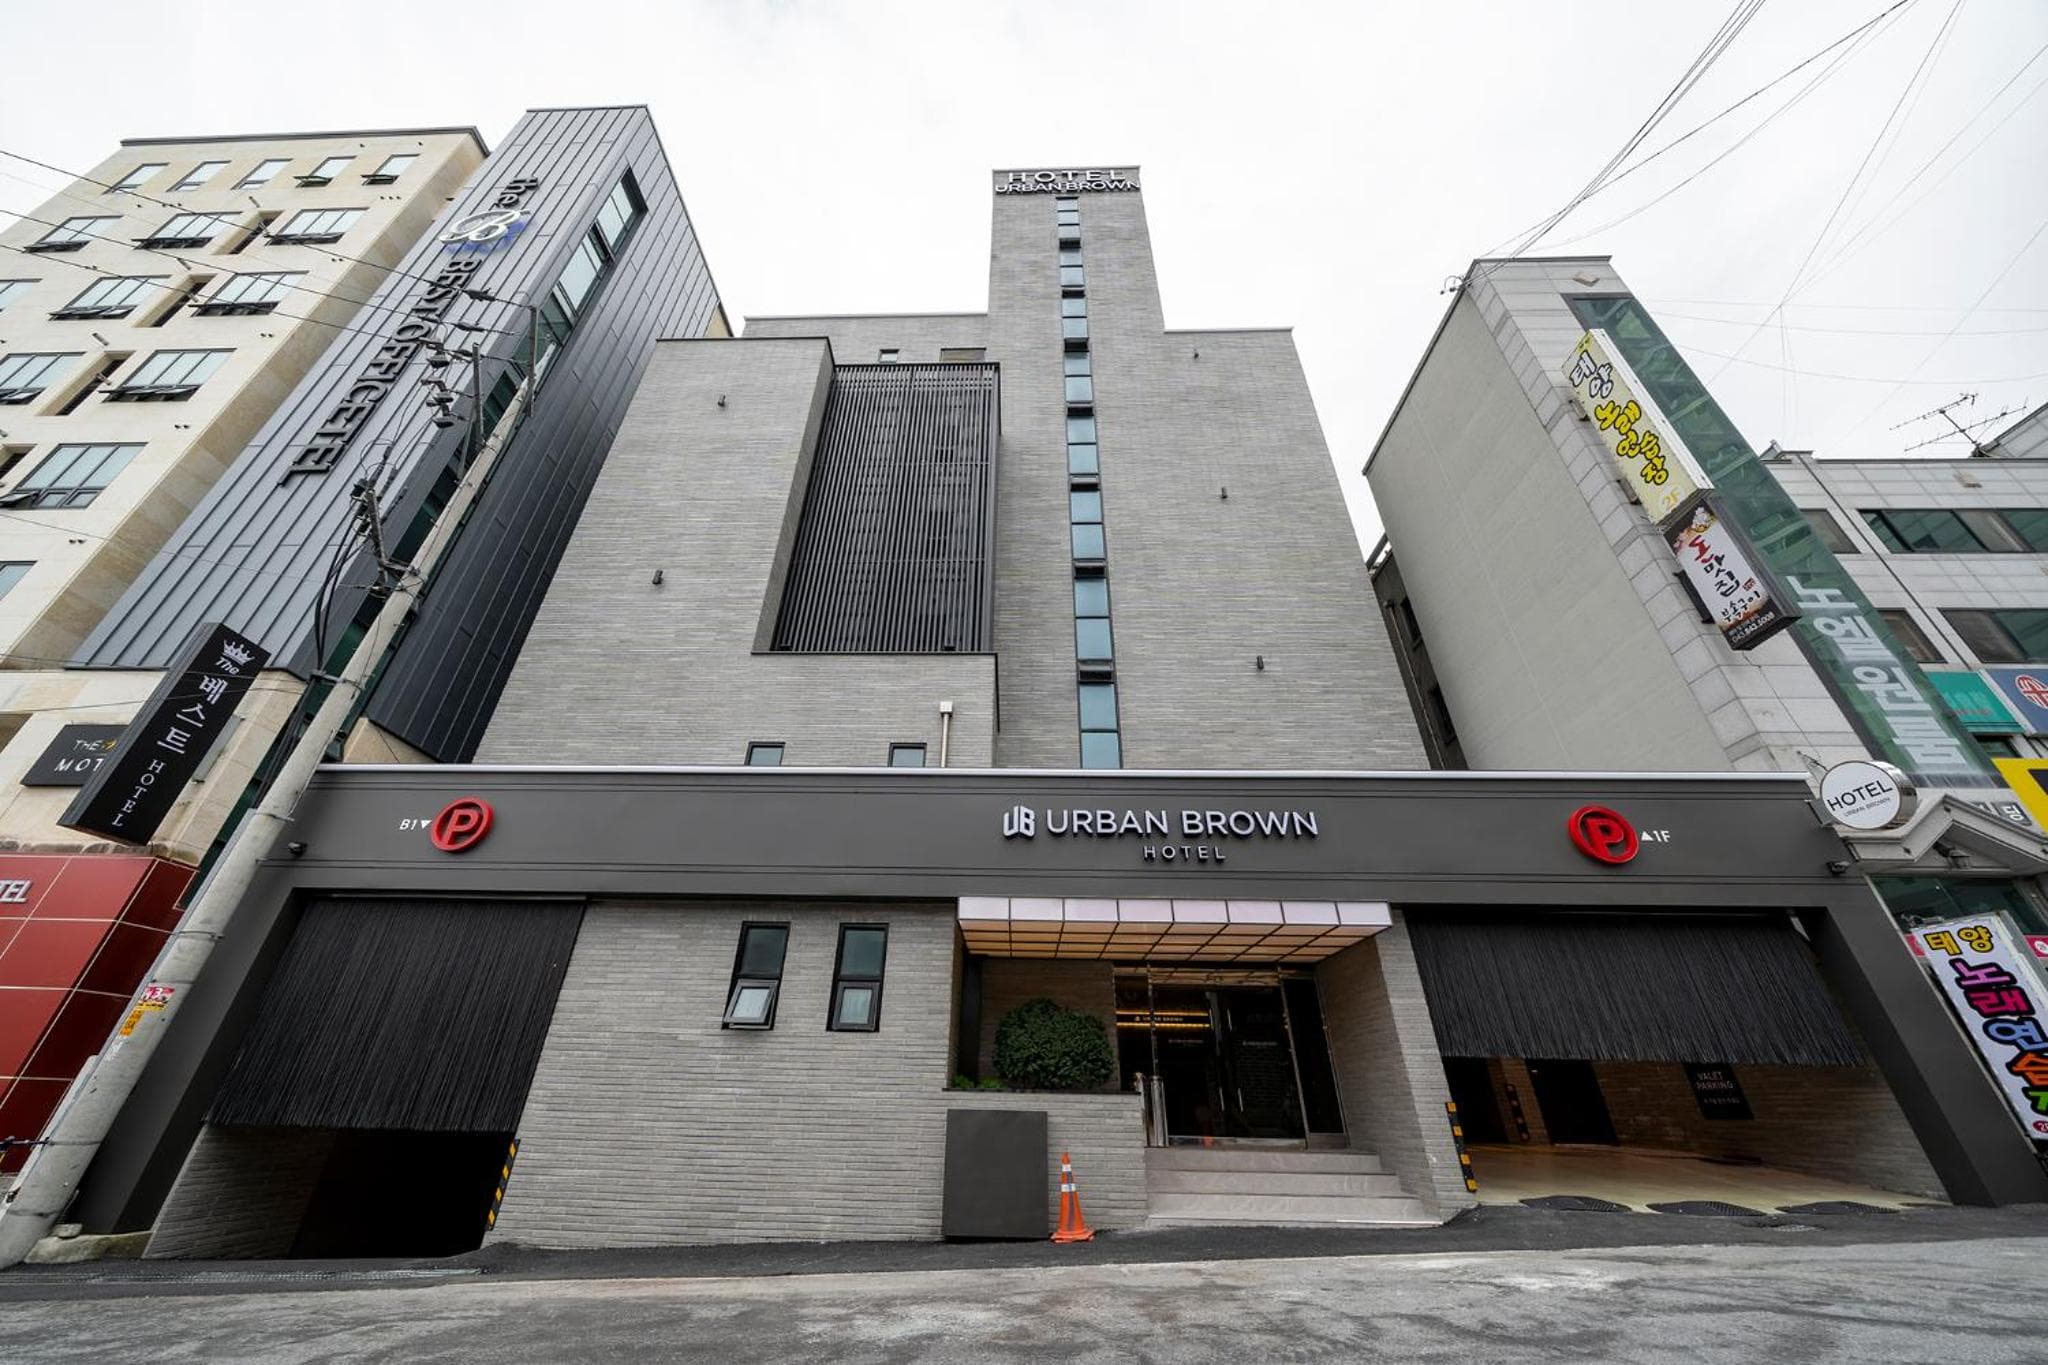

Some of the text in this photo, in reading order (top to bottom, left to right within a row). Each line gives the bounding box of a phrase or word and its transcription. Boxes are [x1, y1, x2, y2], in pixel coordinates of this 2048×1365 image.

[995, 180, 1141, 193] URBAN BROWN
[1008, 169, 1126, 183] HOTEL
[497, 177, 539, 208] the
[1569, 349, 1669, 486] 태양 노래연습장
[1688, 534, 1741, 598] 돈맛집
[1721, 590, 1761, 623] 부속구이
[214, 656, 240, 675] The
[1786, 575, 1968, 765] 노엘원룸
[157, 675, 229, 754] 베스트
[73, 739, 103, 750] THE
[112, 759, 167, 827] HOTEL
[1826, 780, 1894, 812] HOTEL
[400, 818, 418, 831] B1
[1046, 809, 1168, 835] URBAN
[1182, 811, 1319, 837] BROWN
[1652, 830, 1671, 843] 1F
[1143, 845, 1227, 862] HOTEL
[1923, 925, 1994, 956] 태양
